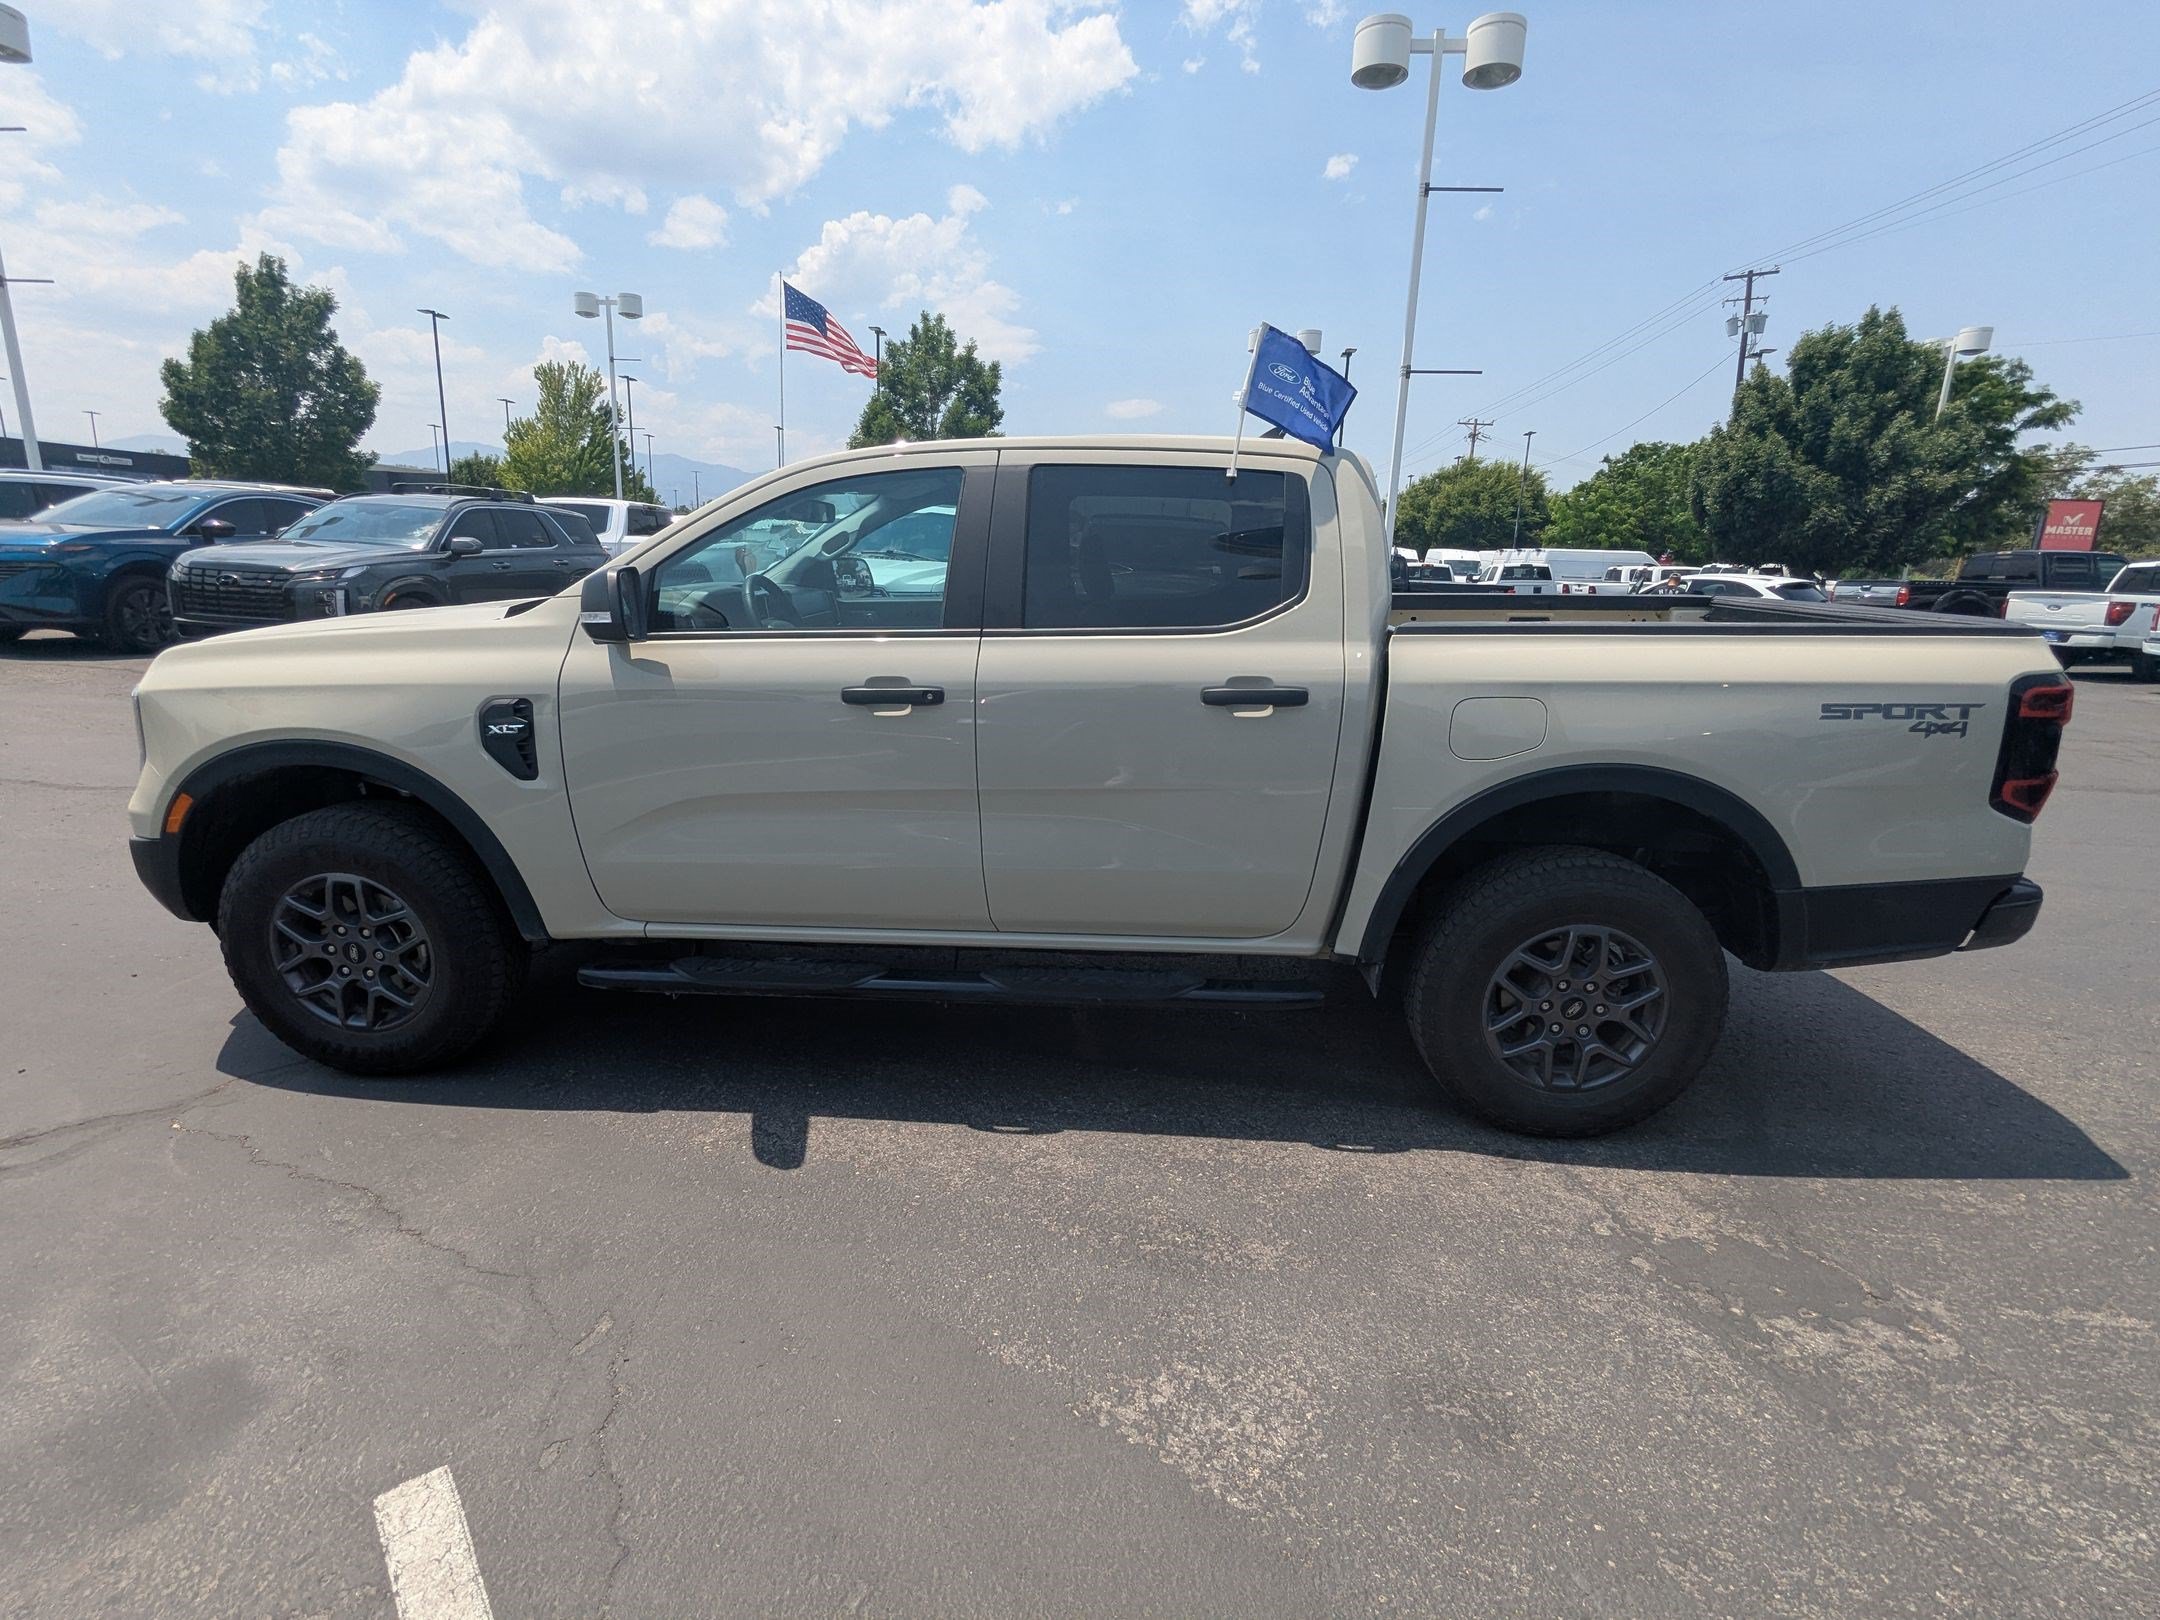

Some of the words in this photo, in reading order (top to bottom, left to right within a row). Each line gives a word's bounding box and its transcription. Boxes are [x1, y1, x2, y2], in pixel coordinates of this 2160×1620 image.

[1273, 365, 1297, 382] Ford
[1303, 376, 1316, 395] Blue
[1257, 382, 1273, 394] Blue
[1273, 390, 1300, 409] Certified
[1300, 405, 1314, 419] Used
[1313, 415, 1329, 433] Vehicle
[2045, 526, 2093, 535] MASTER
[1819, 703, 1986, 720] SPORT
[488, 725, 525, 734] XLT
